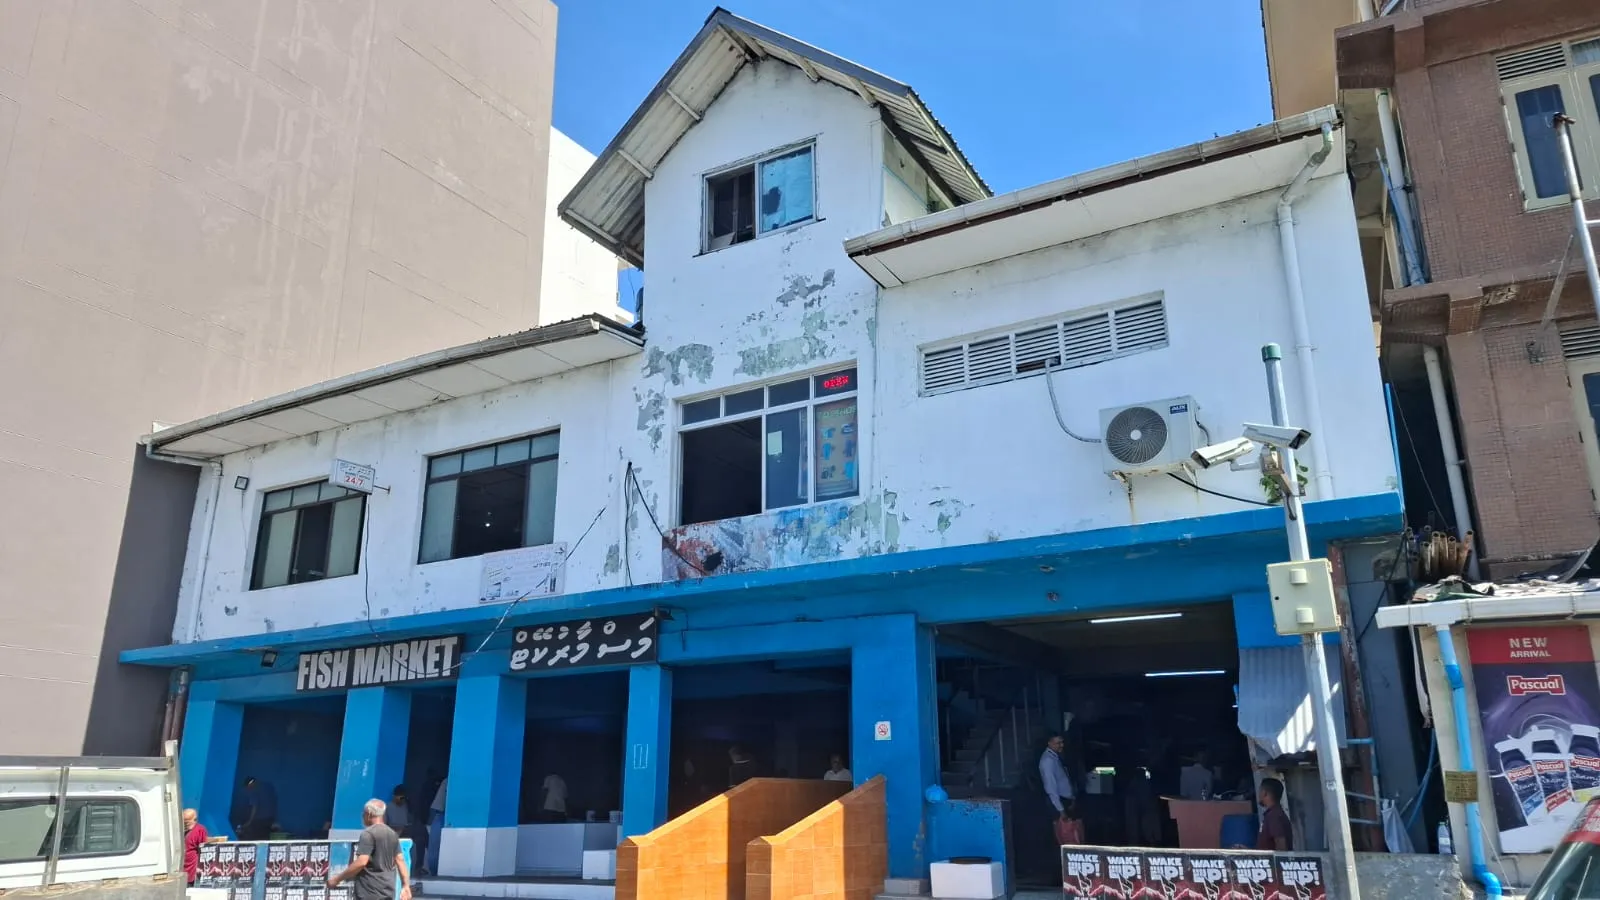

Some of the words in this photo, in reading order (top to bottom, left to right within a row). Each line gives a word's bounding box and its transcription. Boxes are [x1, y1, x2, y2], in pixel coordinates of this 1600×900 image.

[1508, 637, 1548, 648] NEW
[1510, 650, 1552, 658] ARRIVAL
[296, 650, 349, 690] FISH
[352, 636, 458, 686] MARKET
[1511, 679, 1560, 690] Pascual
[1067, 853, 1098, 861] WAKE
[1107, 856, 1139, 864] WAKE
[1148, 858, 1182, 866] WAKE
[1191, 860, 1225, 868] WAKE
[1235, 860, 1269, 868] WAKE
[1281, 862, 1317, 870] WAKE
